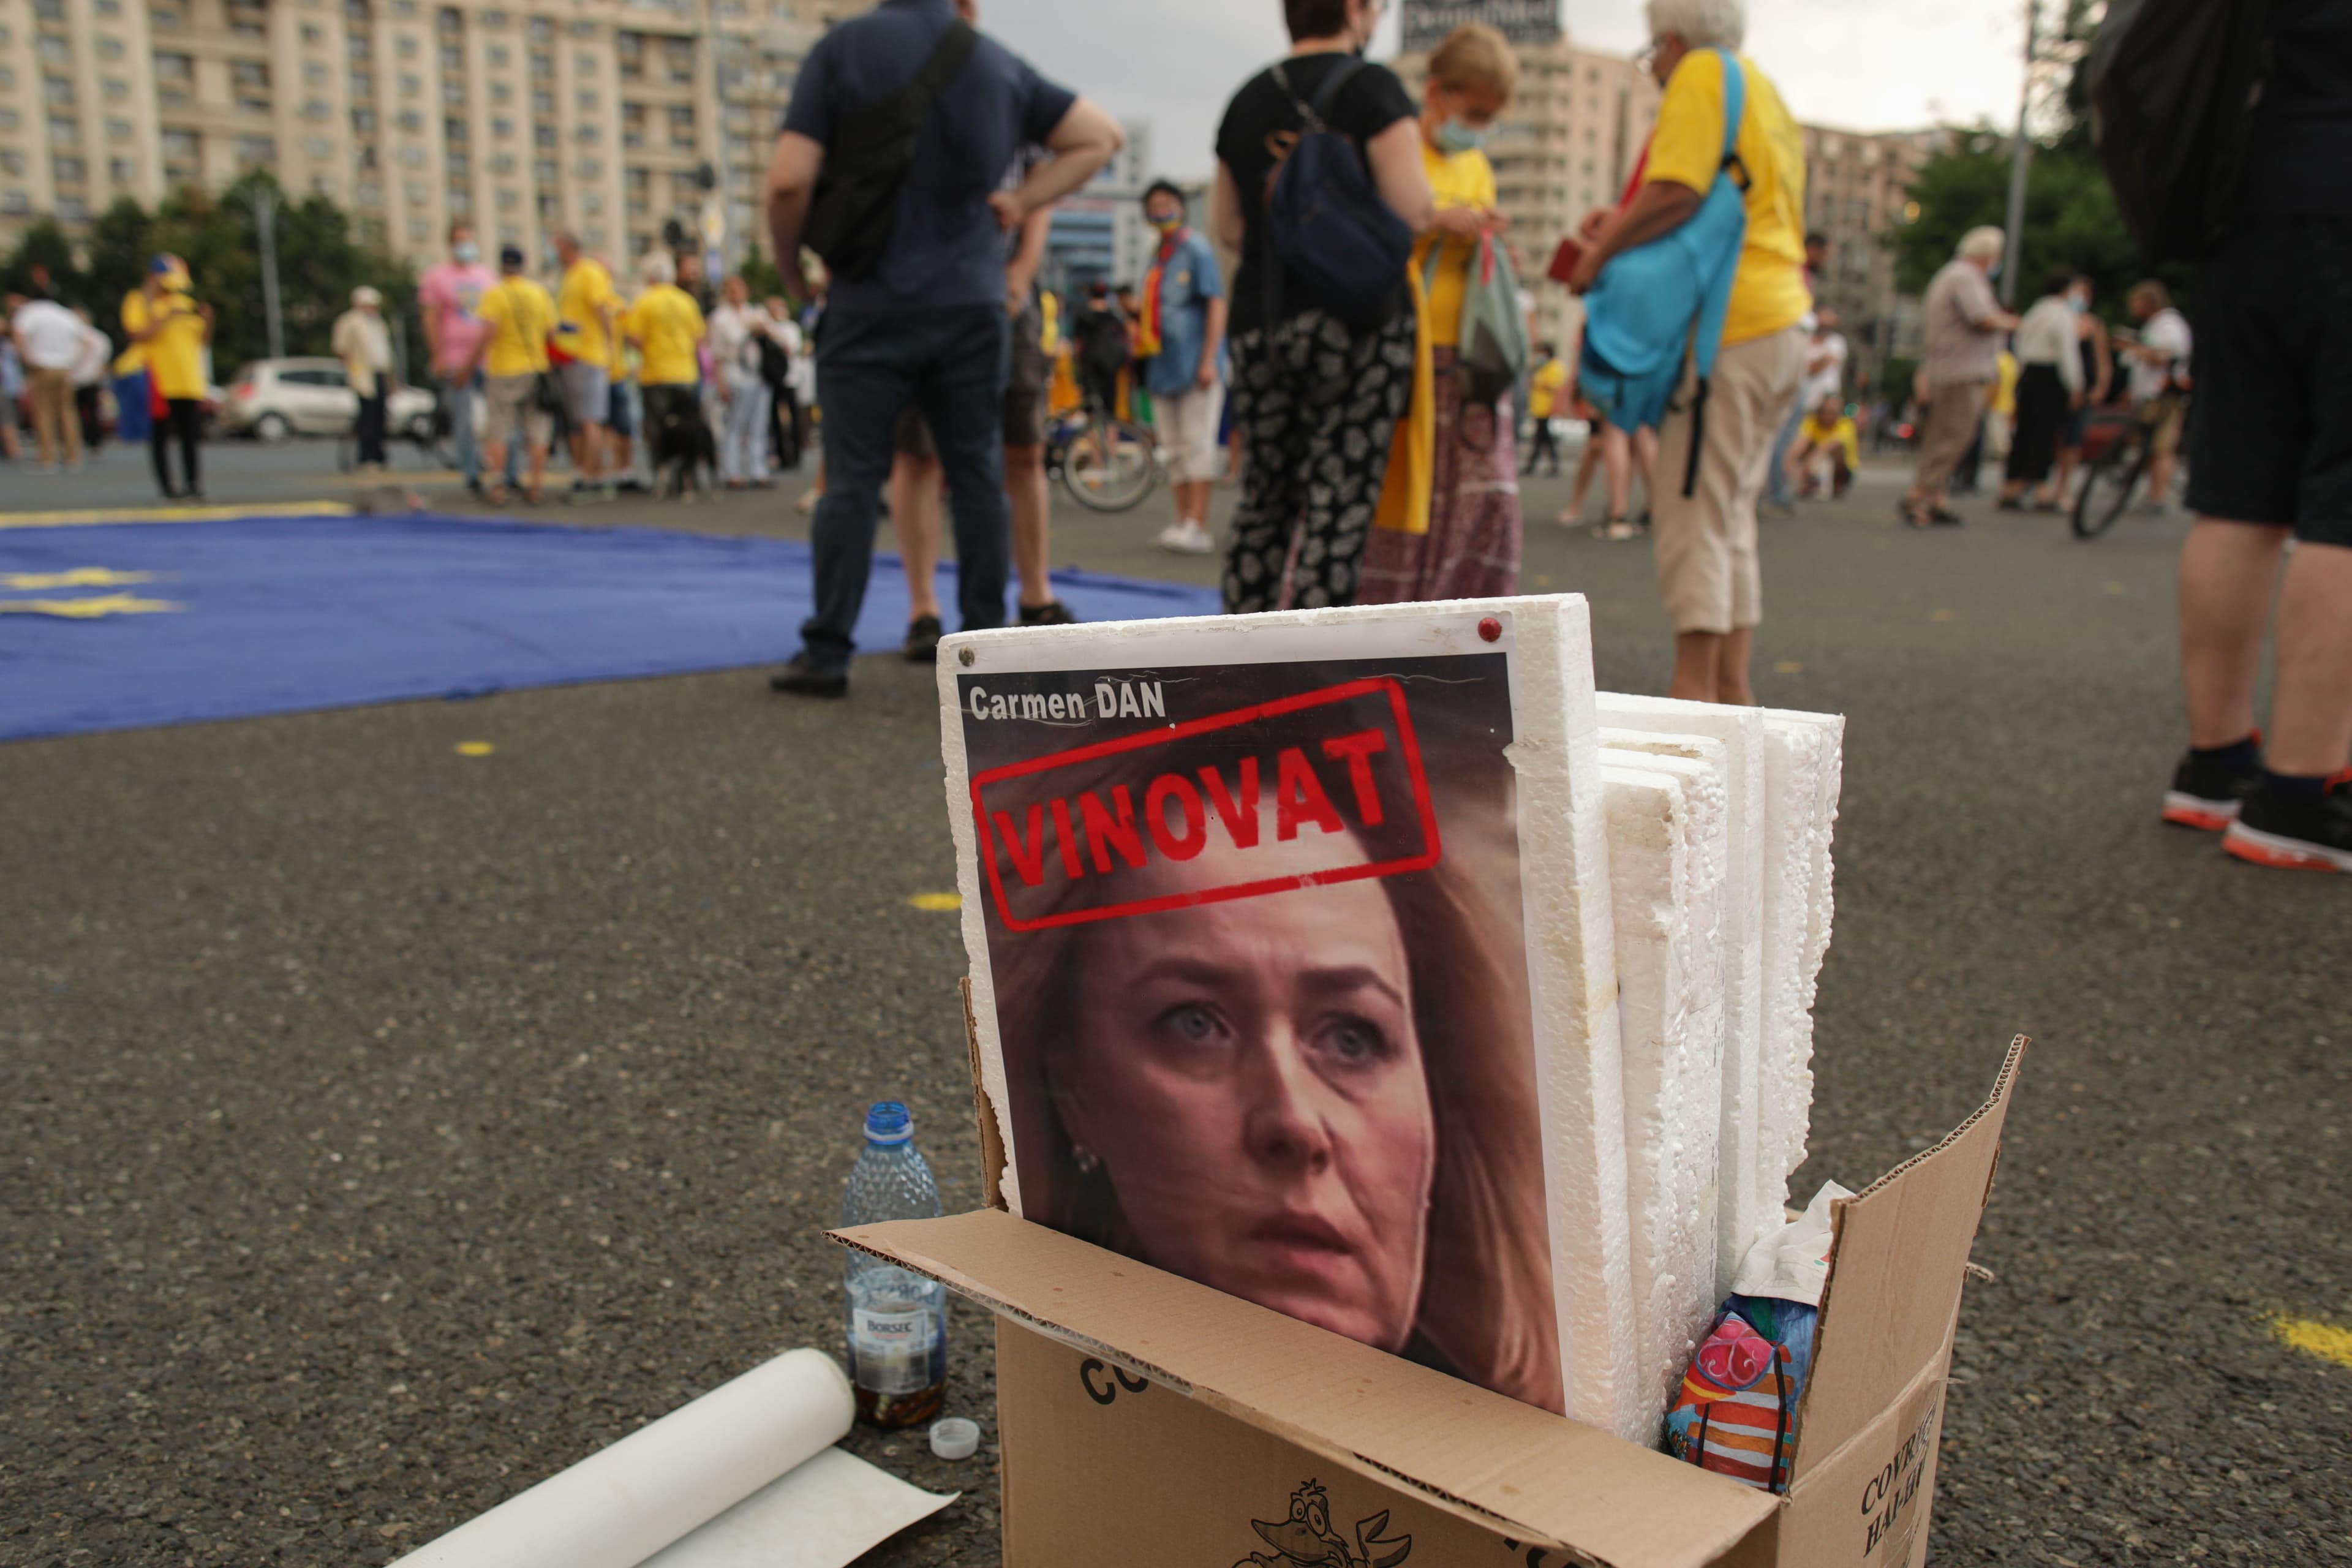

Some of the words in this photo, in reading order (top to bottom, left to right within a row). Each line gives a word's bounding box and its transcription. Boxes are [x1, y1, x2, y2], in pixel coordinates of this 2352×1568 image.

[970, 685, 1086, 720] Carmen
[1094, 681, 1166, 718] DAN
[993, 728, 1387, 888] VINOVAT
